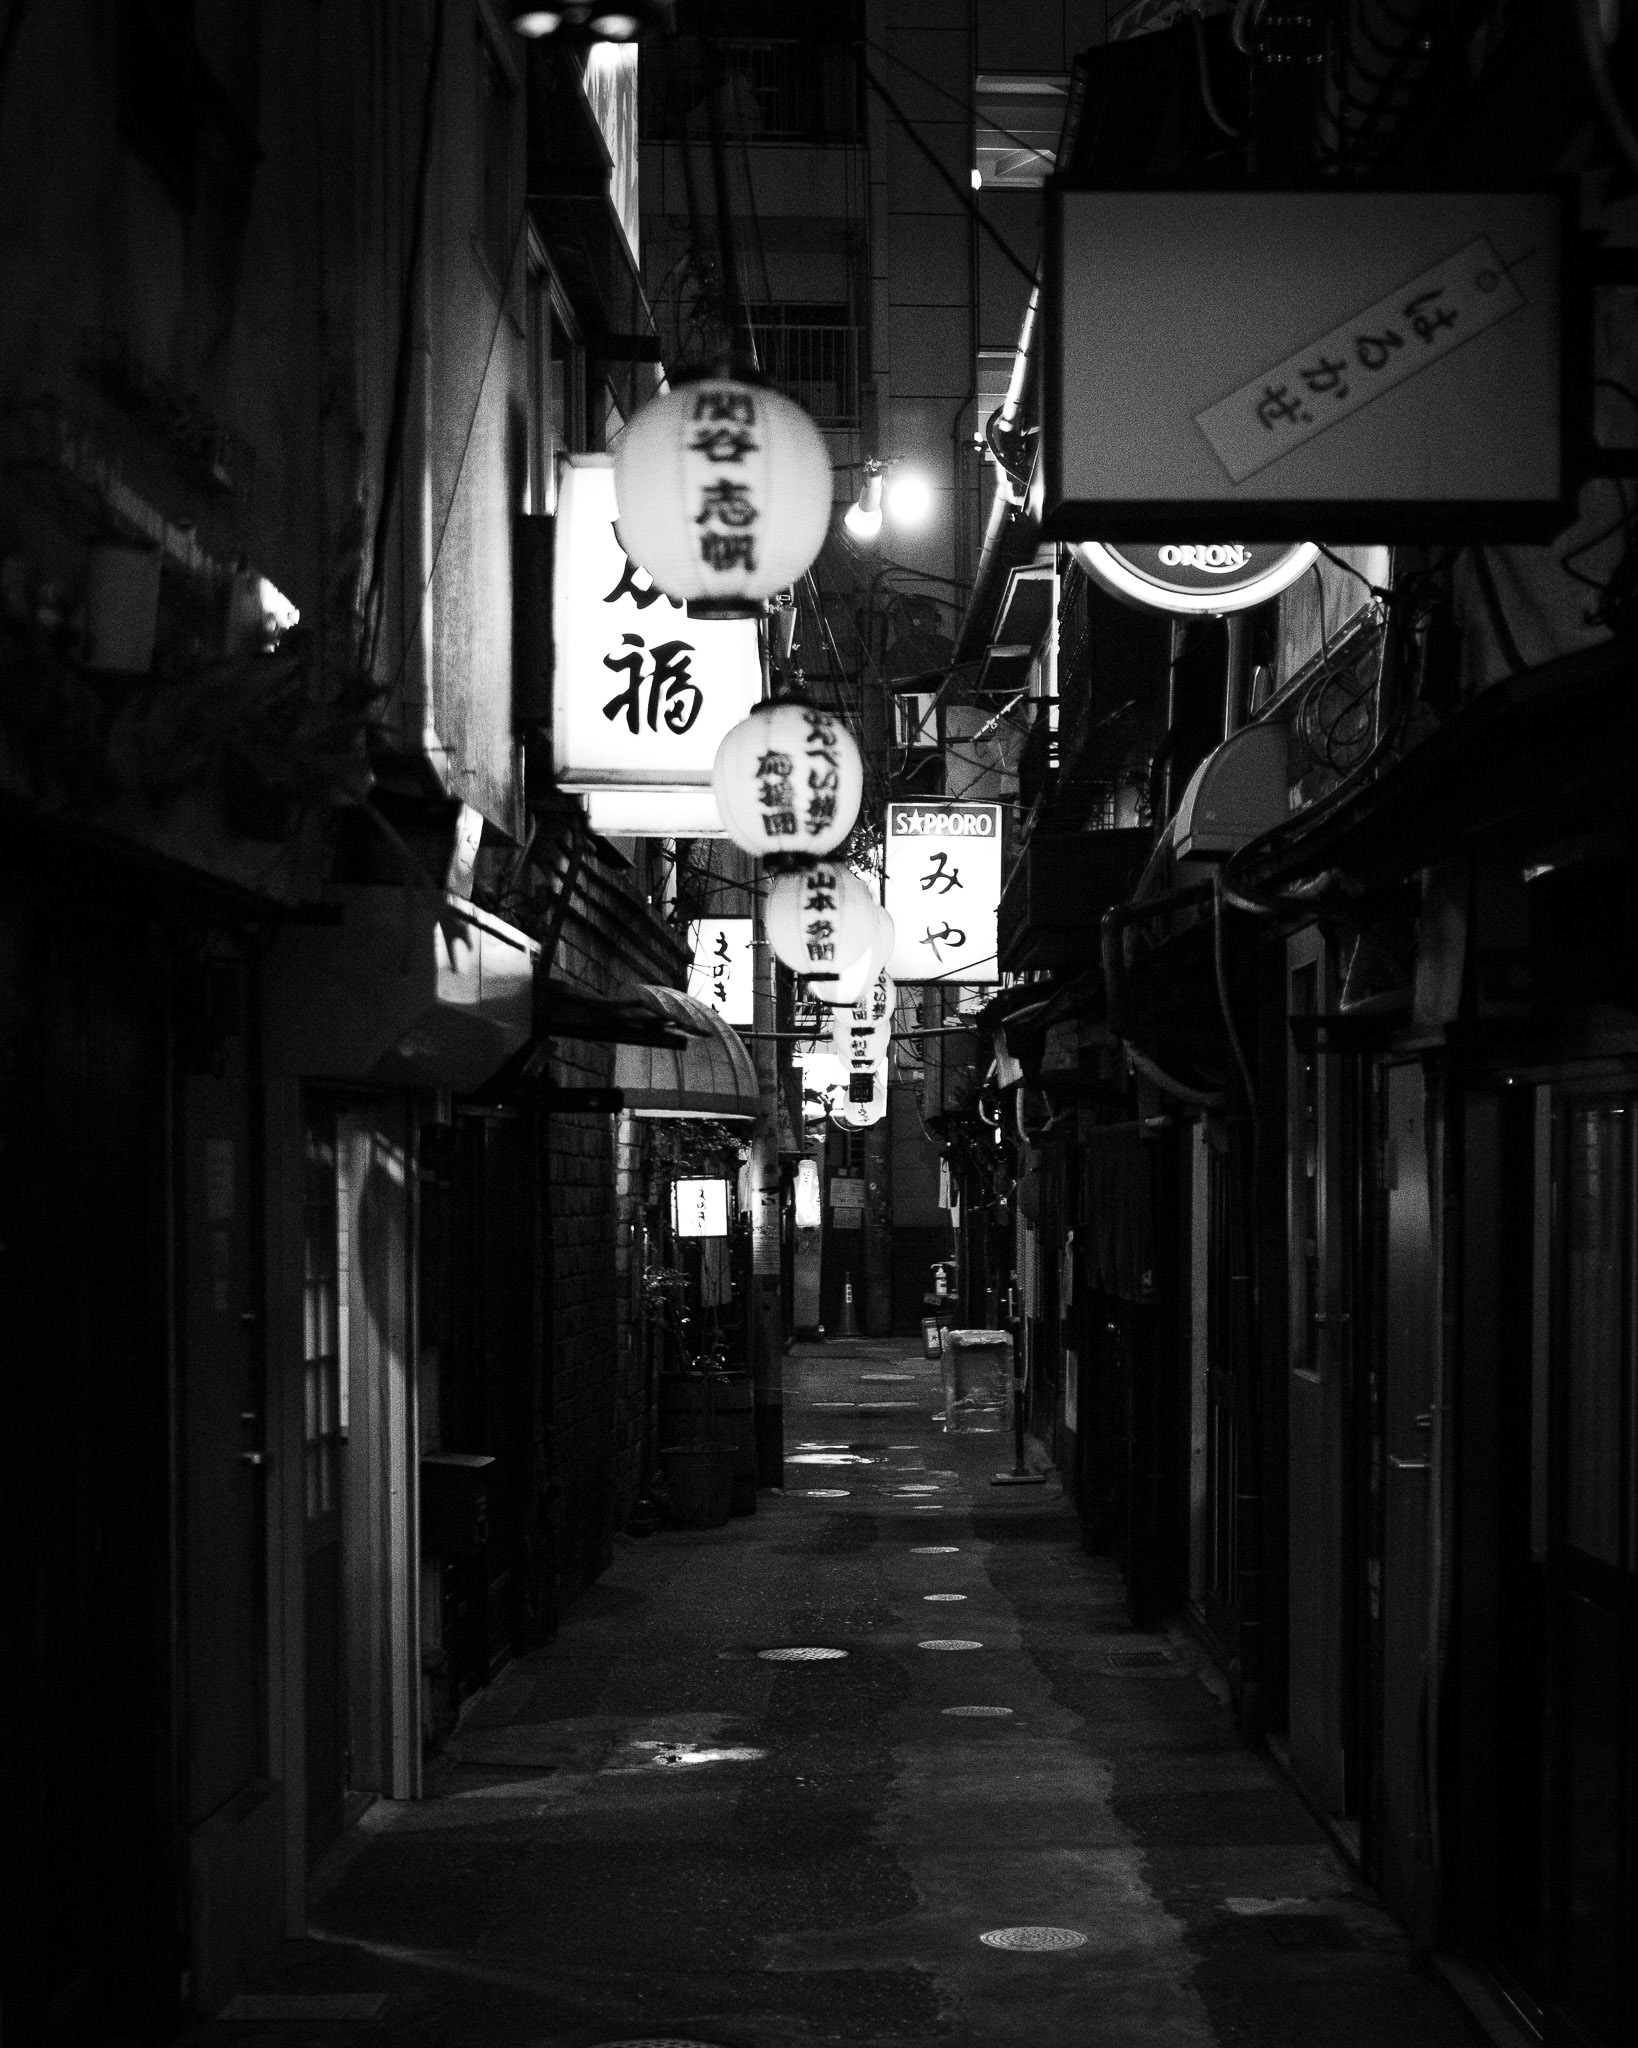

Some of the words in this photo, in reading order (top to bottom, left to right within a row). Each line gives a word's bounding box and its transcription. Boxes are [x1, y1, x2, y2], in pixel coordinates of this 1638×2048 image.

[1256, 289, 1459, 431] はるかぜ
[1157, 544, 1248, 571] ORION
[895, 808, 992, 836] SAPPORO
[919, 851, 966, 964] みや
